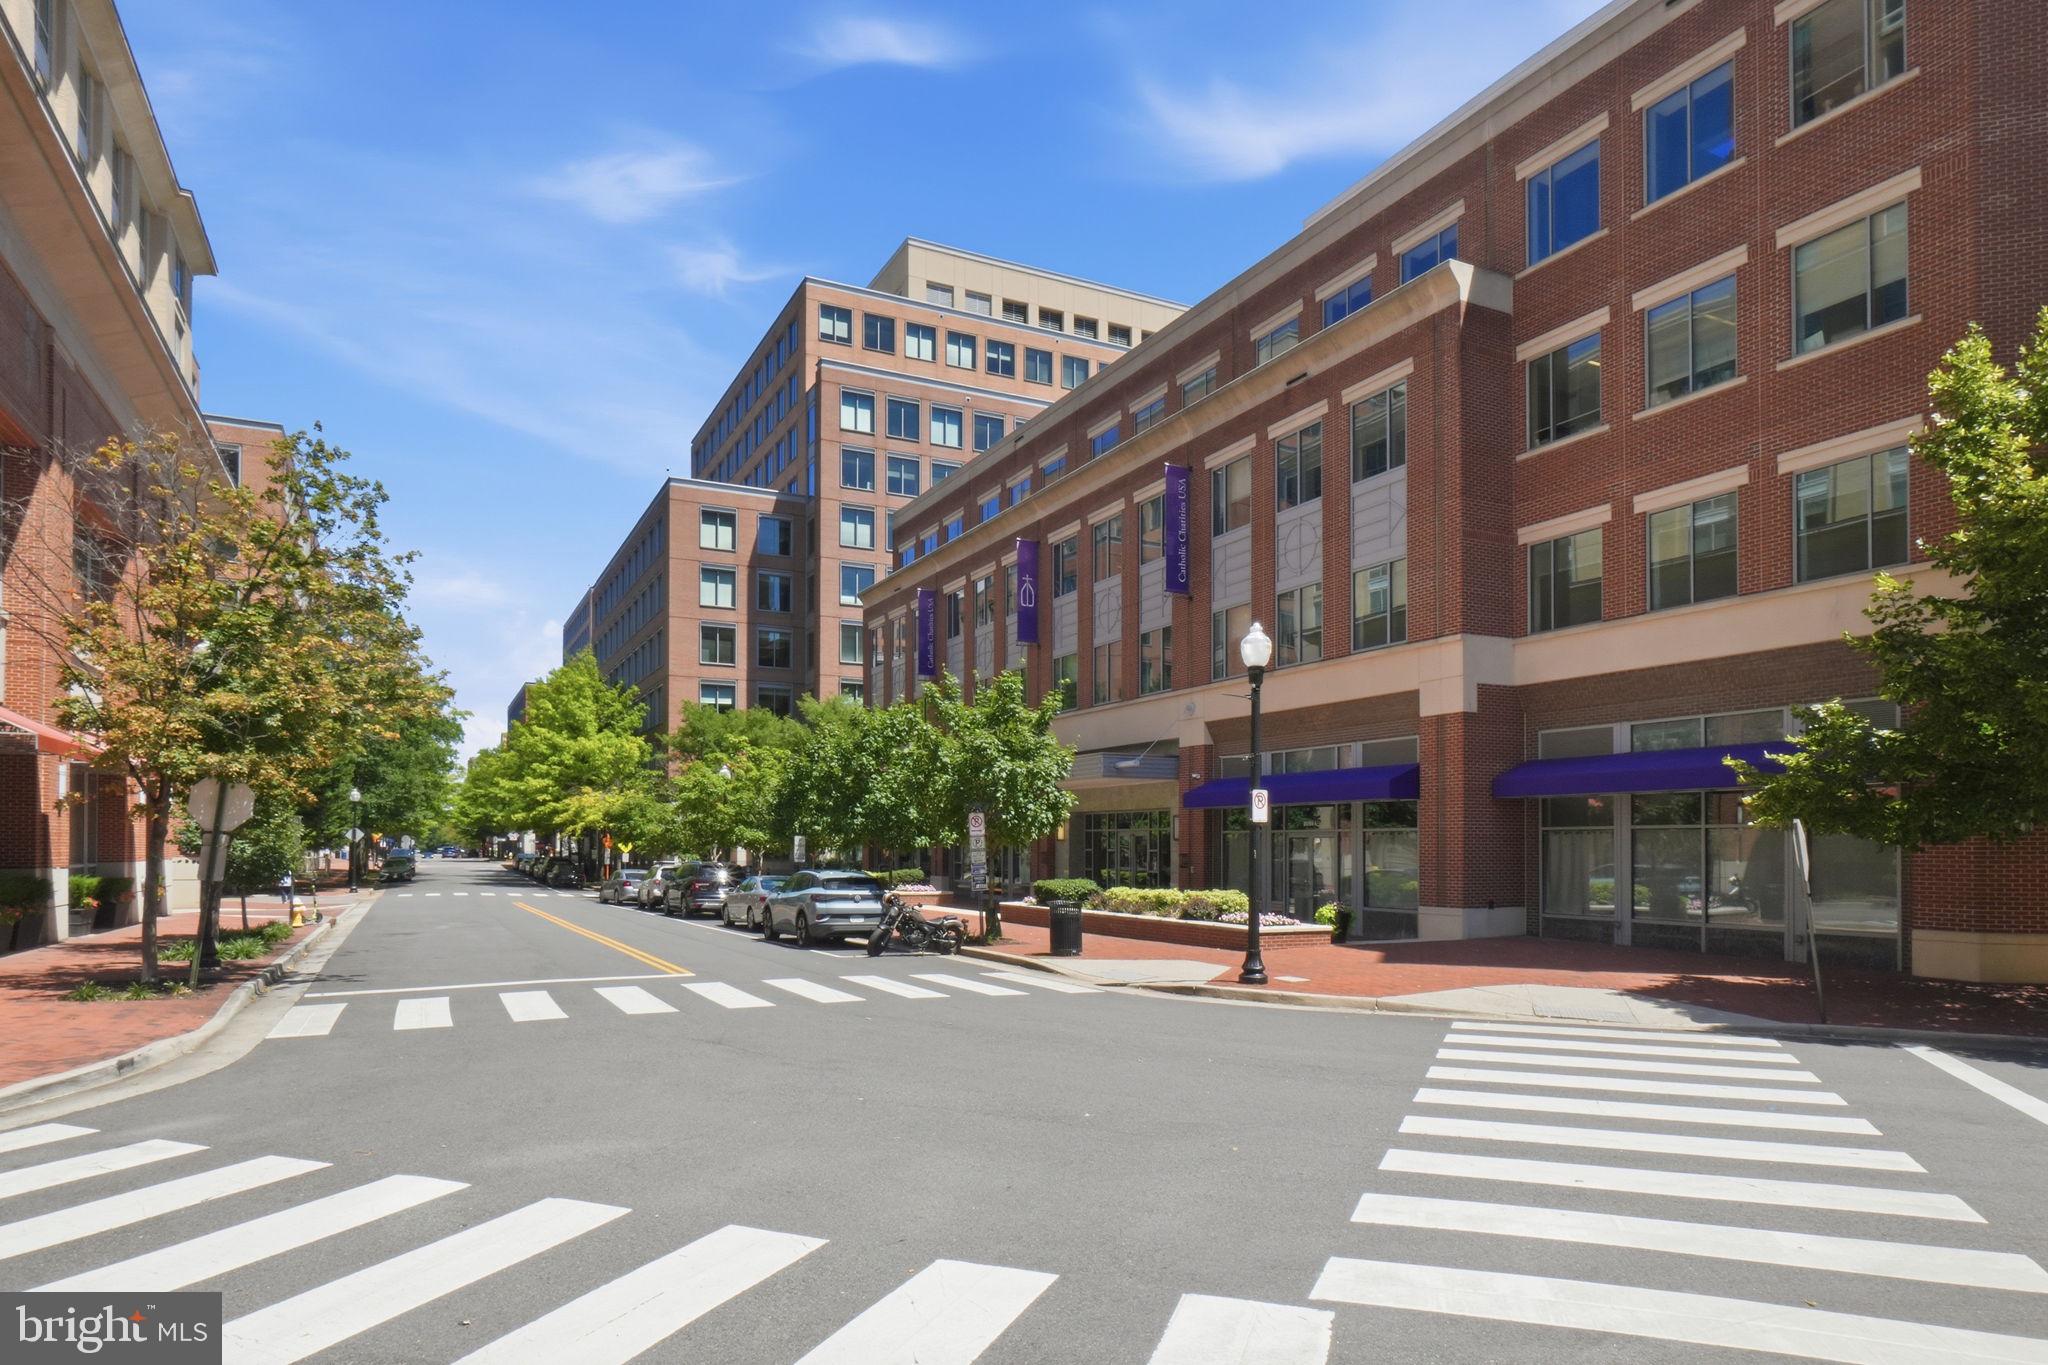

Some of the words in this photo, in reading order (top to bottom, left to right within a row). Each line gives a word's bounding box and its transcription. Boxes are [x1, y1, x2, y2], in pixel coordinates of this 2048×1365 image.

[1178, 478, 1187, 500] USA
[1178, 501, 1187, 542] Charities
[1178, 543, 1187, 583] Catholic
